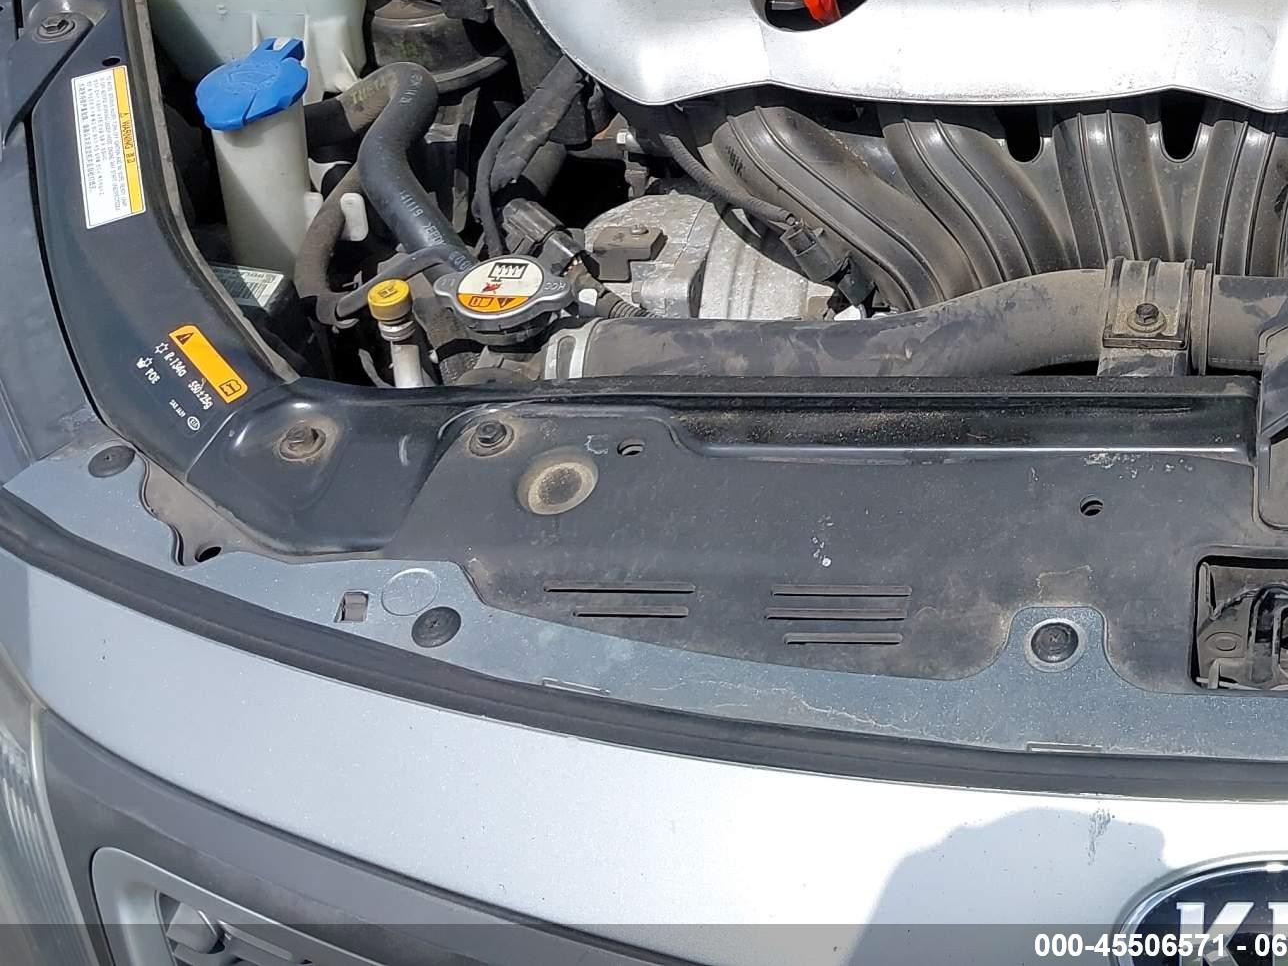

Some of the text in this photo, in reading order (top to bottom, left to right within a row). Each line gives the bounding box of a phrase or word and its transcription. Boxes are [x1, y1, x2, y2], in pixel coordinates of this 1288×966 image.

[122, 121, 134, 150] WARNING
[145, 367, 161, 384] POE
[163, 351, 187, 377] R-134a
